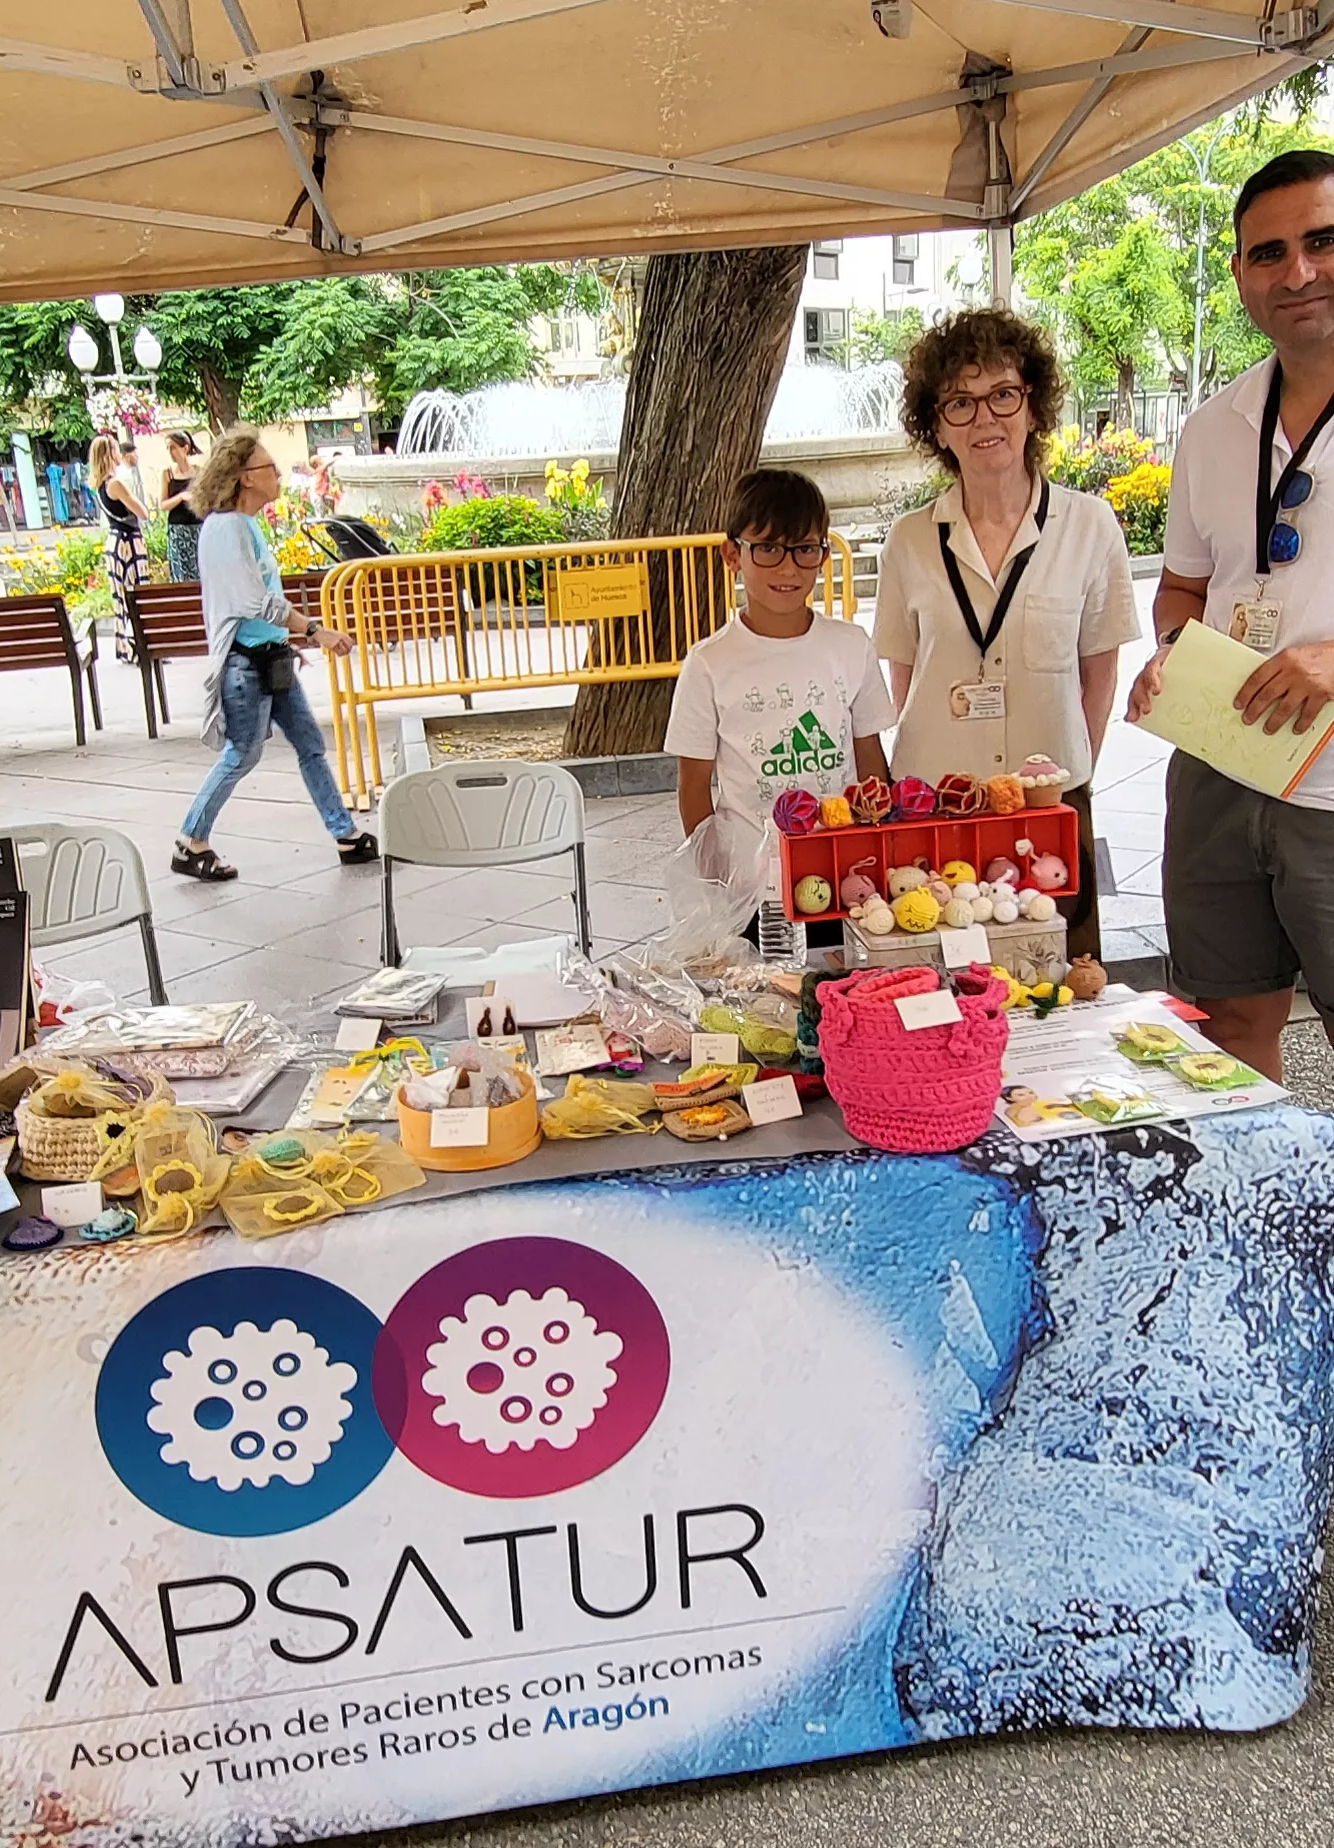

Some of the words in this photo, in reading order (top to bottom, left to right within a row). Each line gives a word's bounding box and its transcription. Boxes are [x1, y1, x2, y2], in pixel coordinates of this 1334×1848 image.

[761, 749, 845, 776] adidas
[45, 1503, 770, 1702] APSATUR
[70, 1719, 272, 1770] Asociación
[283, 1708, 329, 1738] de
[339, 1685, 511, 1729] Pacientes
[522, 1671, 585, 1700] con
[596, 1646, 763, 1689] Sarcomas
[180, 1769, 200, 1798] y
[206, 1742, 369, 1785] Tumores
[379, 1724, 477, 1760] Raros
[488, 1713, 532, 1741] de
[542, 1693, 670, 1733] Aragón
